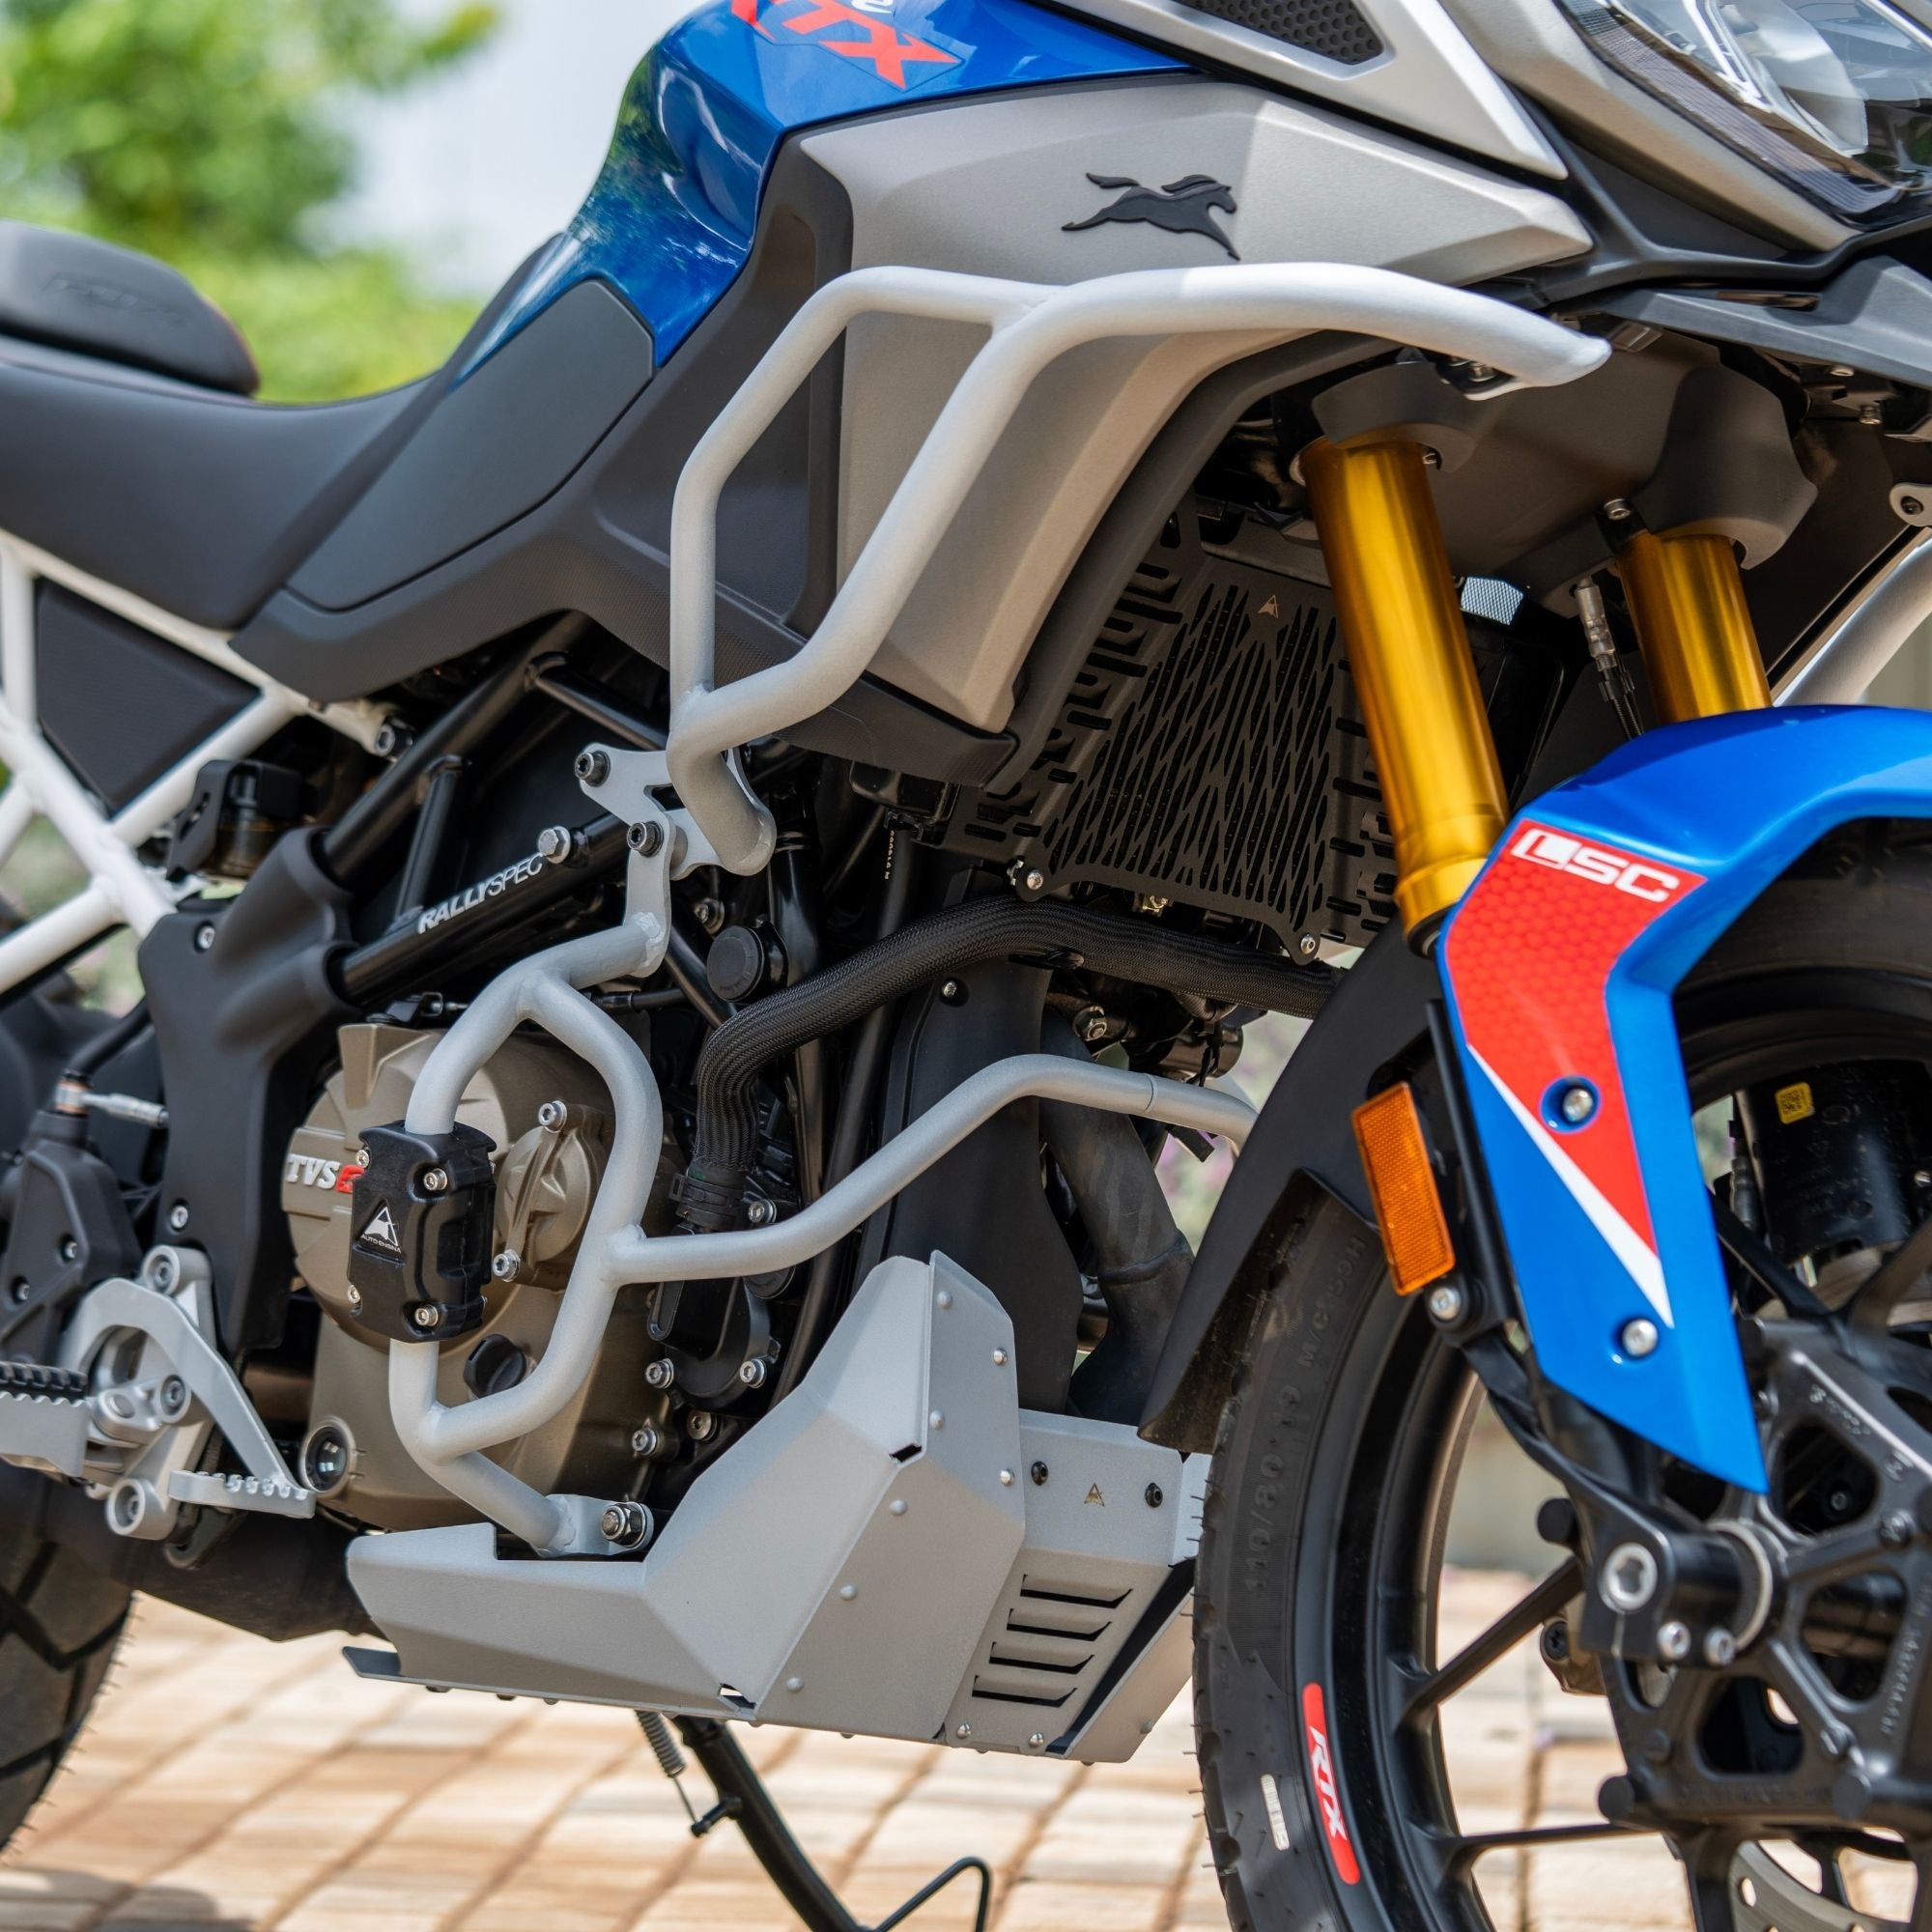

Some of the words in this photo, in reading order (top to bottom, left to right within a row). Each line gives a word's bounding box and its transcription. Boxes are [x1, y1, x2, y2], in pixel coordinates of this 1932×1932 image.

[417, 852, 543, 935] RALLYSPEC
[1510, 828, 1680, 903] LSC
[286, 1153, 341, 1190] TVS
[1309, 1725, 1349, 1840] RTX
